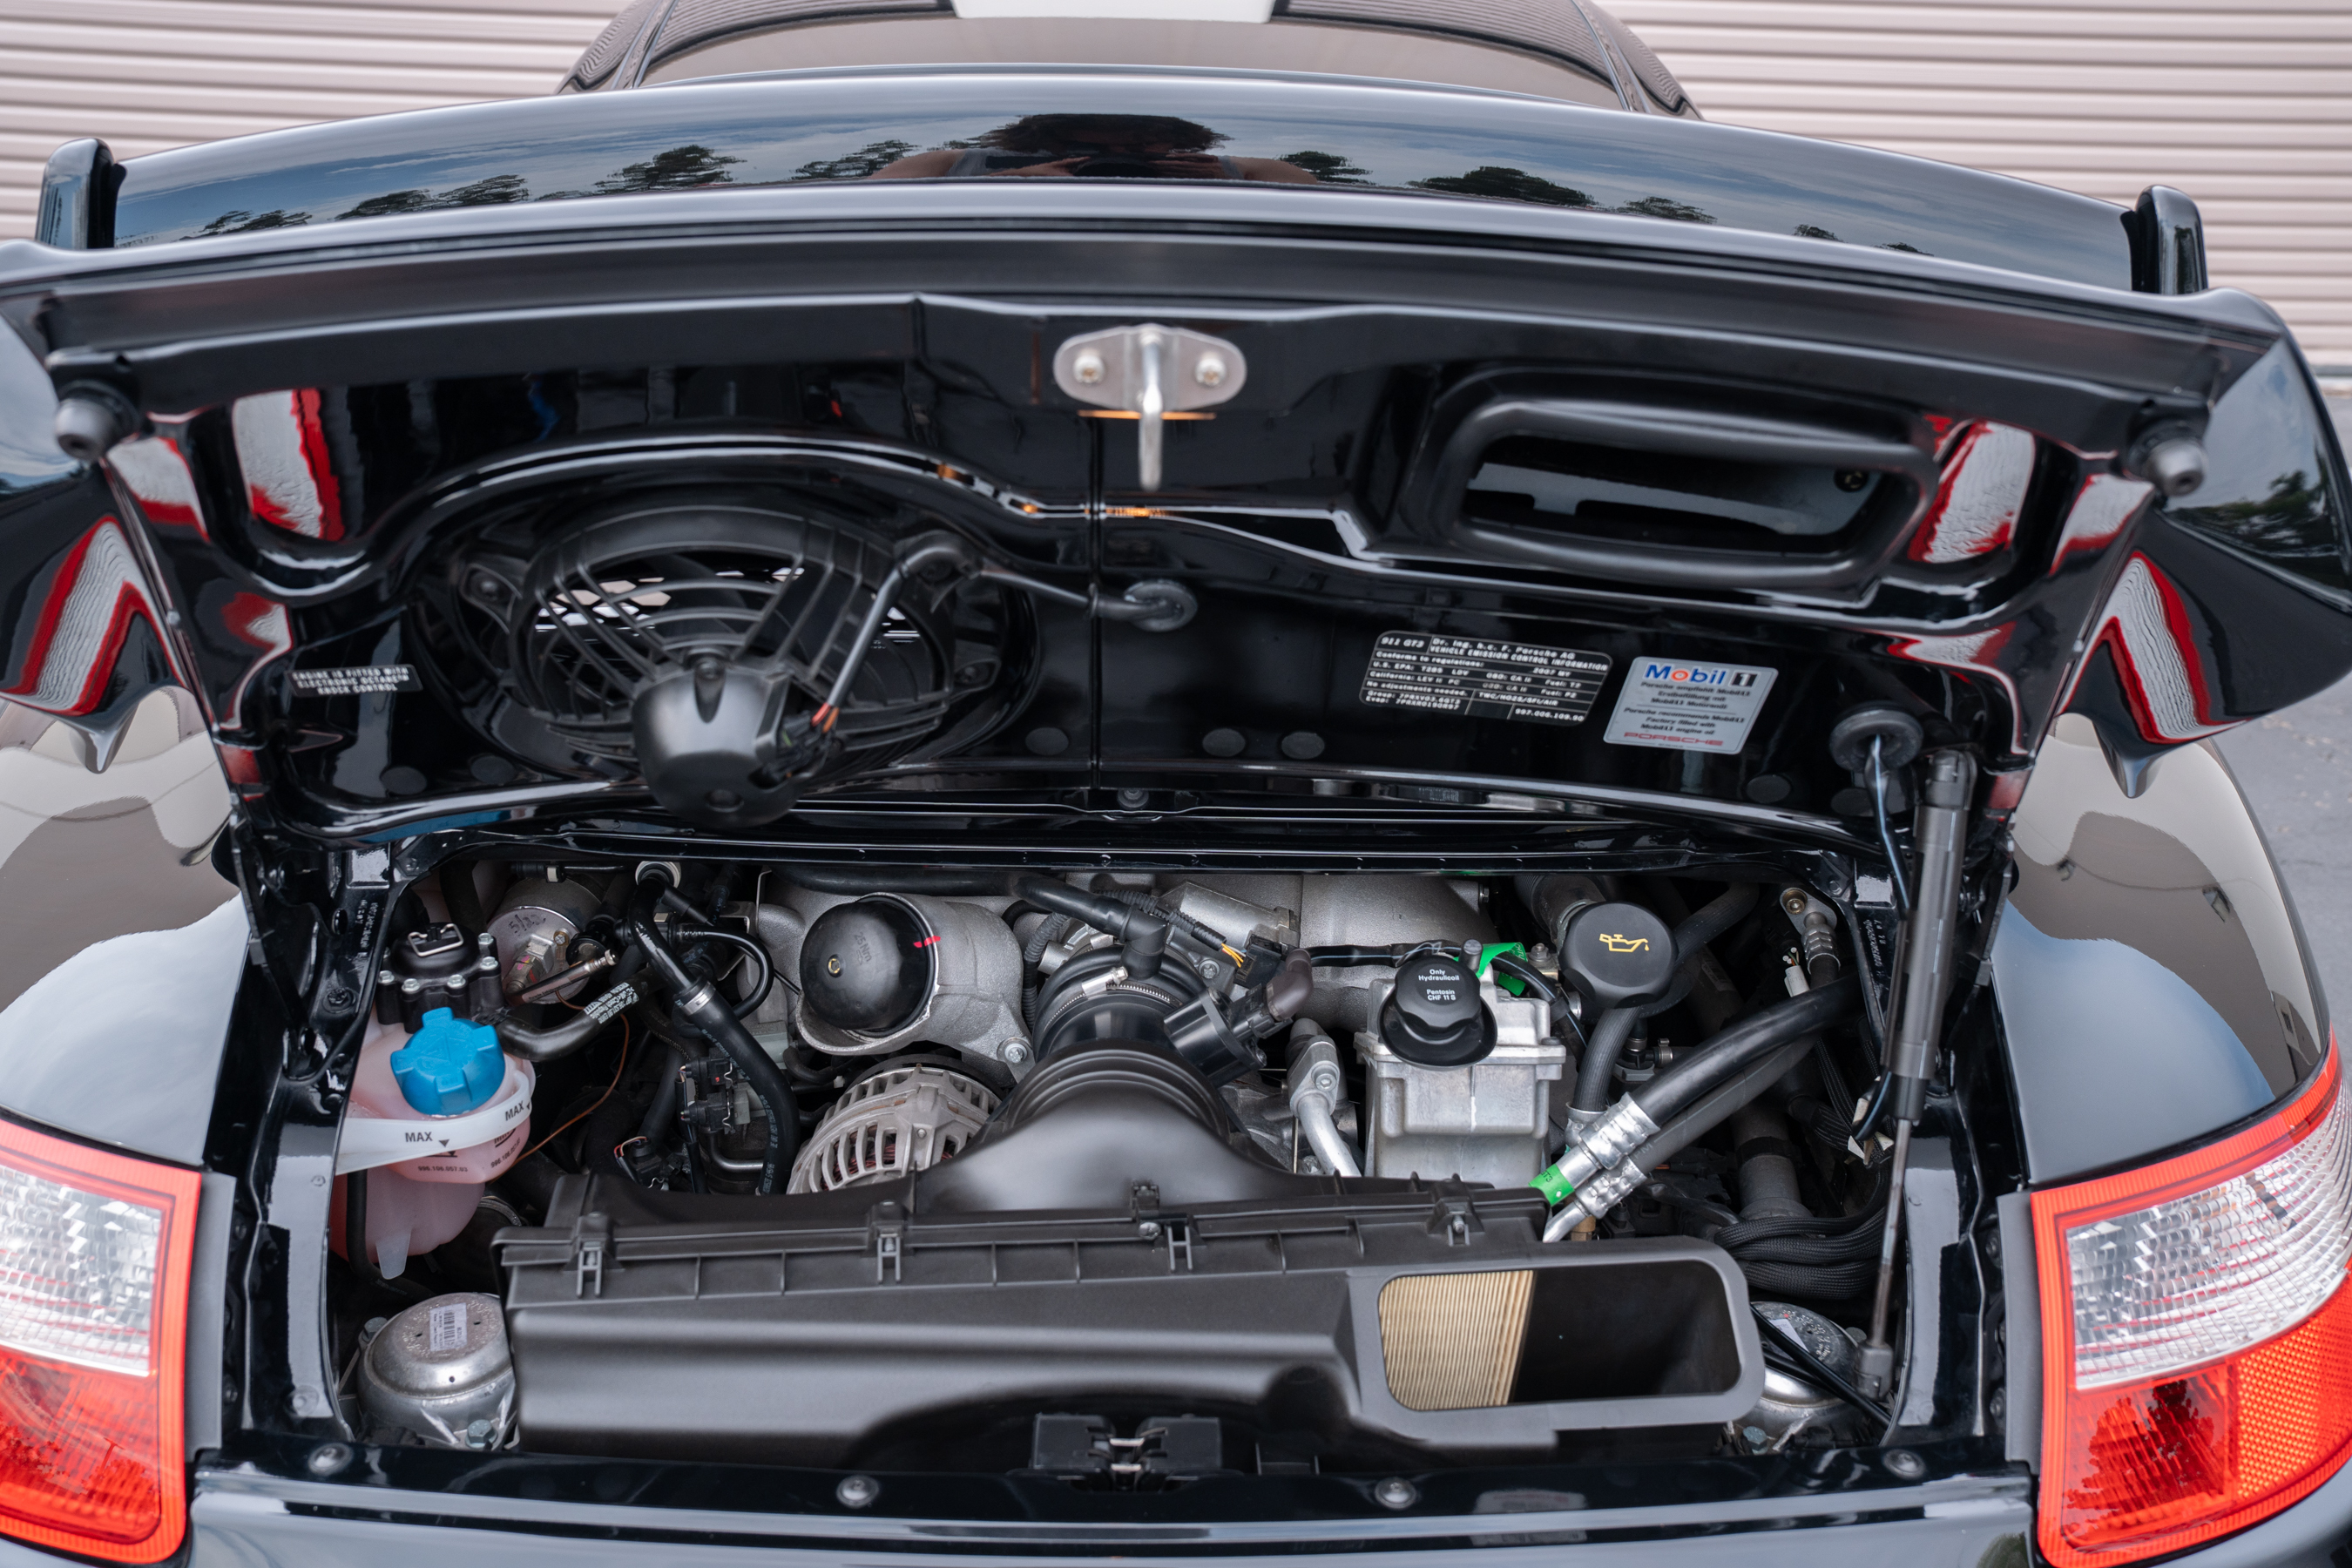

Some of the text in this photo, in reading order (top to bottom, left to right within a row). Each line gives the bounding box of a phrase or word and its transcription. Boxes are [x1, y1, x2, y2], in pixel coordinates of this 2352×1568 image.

[1381, 637, 1424, 648] 911 GT3
[1453, 640, 1472, 649] Ing.
[1477, 643, 1497, 651] h.c.
[1516, 646, 1557, 658] Porsche
[1376, 651, 1417, 661] Conforms
[1432, 657, 1484, 667] regulations:
[1430, 646, 1608, 671] VEHICLE EMISSION CONTROL INFORMATION
[1370, 671, 1415, 681] California:
[1645, 665, 1727, 685] Mobil
[1381, 682, 1432, 693] adjustments
[1434, 688, 1468, 696] needed.
[1658, 710, 1710, 720] recommends
[1624, 732, 1724, 746] PORSCHE
[505, 1100, 524, 1121] MAX
[406, 1132, 433, 1142] MAX
